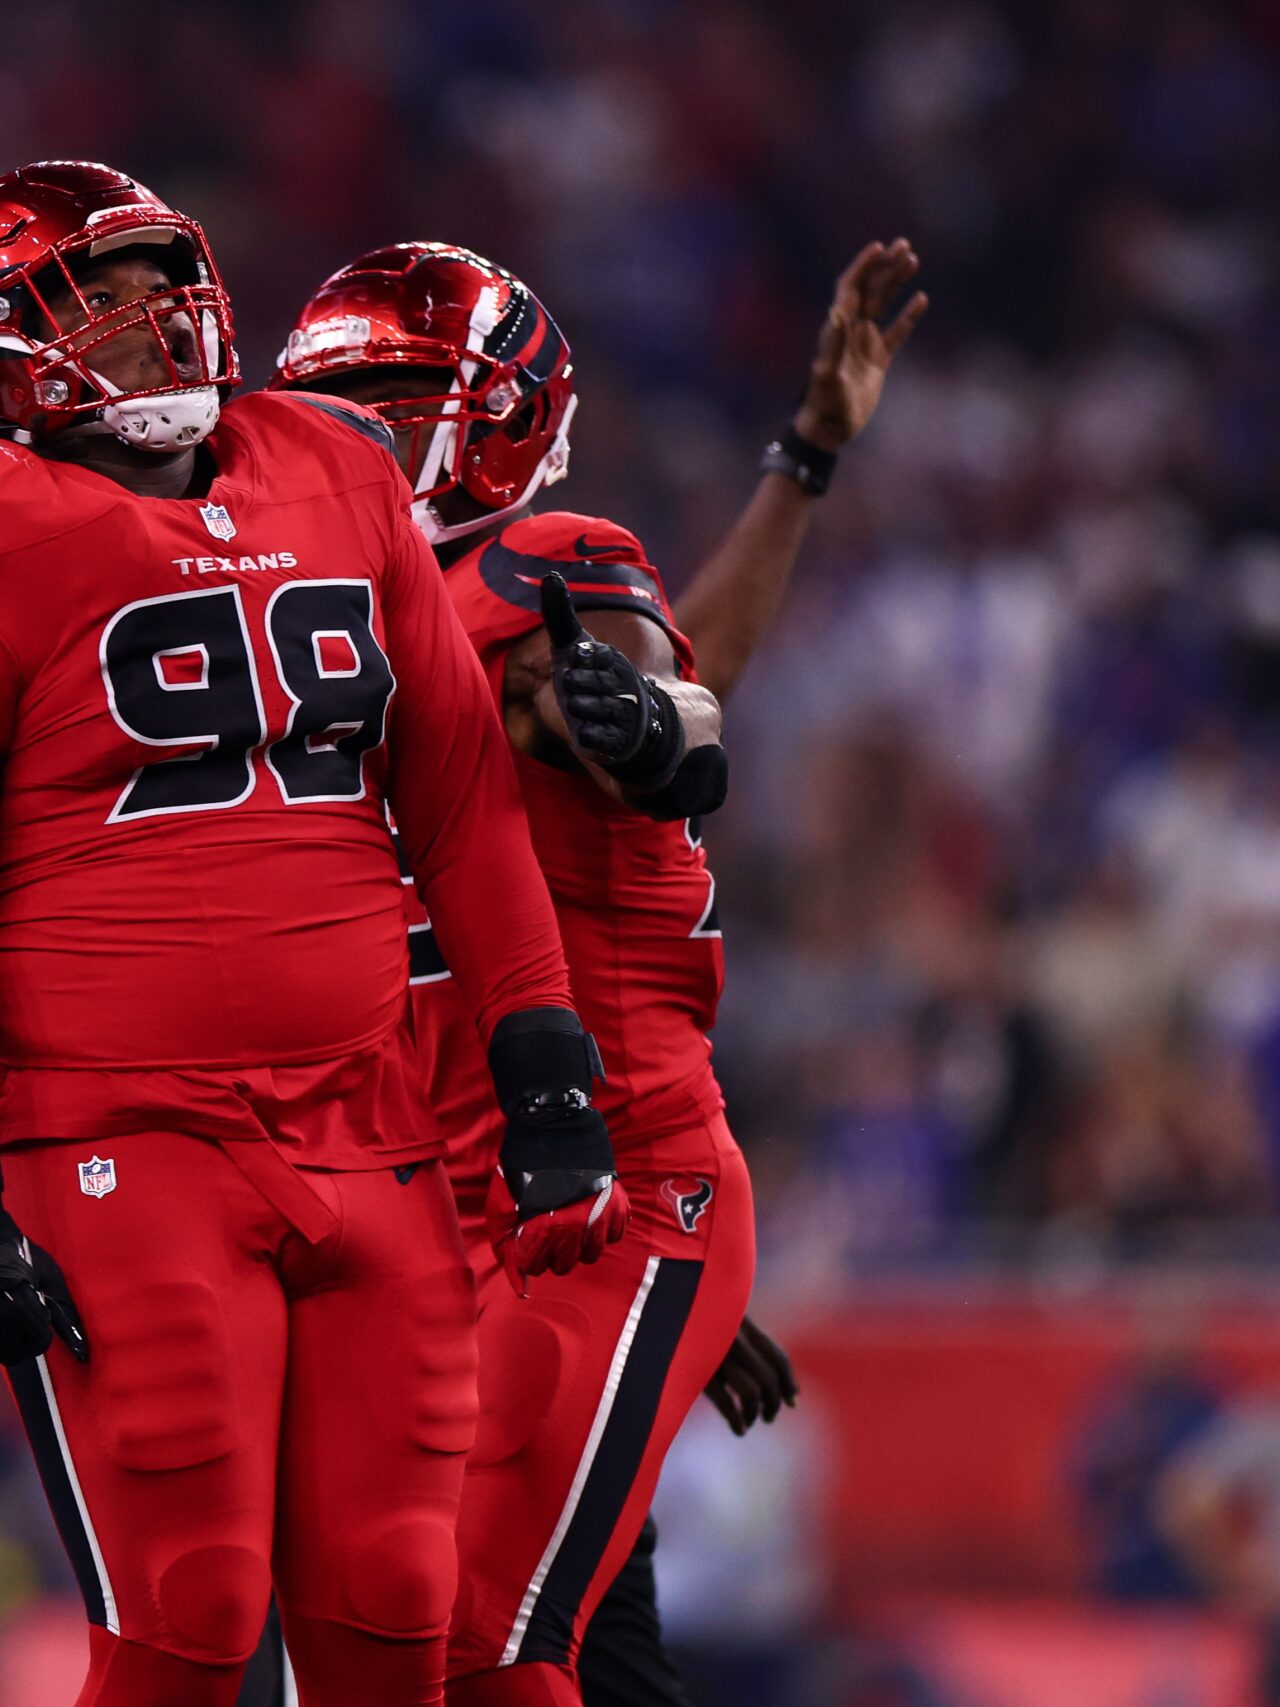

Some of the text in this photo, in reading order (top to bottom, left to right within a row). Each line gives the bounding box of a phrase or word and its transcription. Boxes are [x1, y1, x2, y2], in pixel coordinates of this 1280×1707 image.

[171, 552, 298, 576] TEXANS
[99, 578, 397, 825] 98
[86, 1173, 111, 1190] NFL
